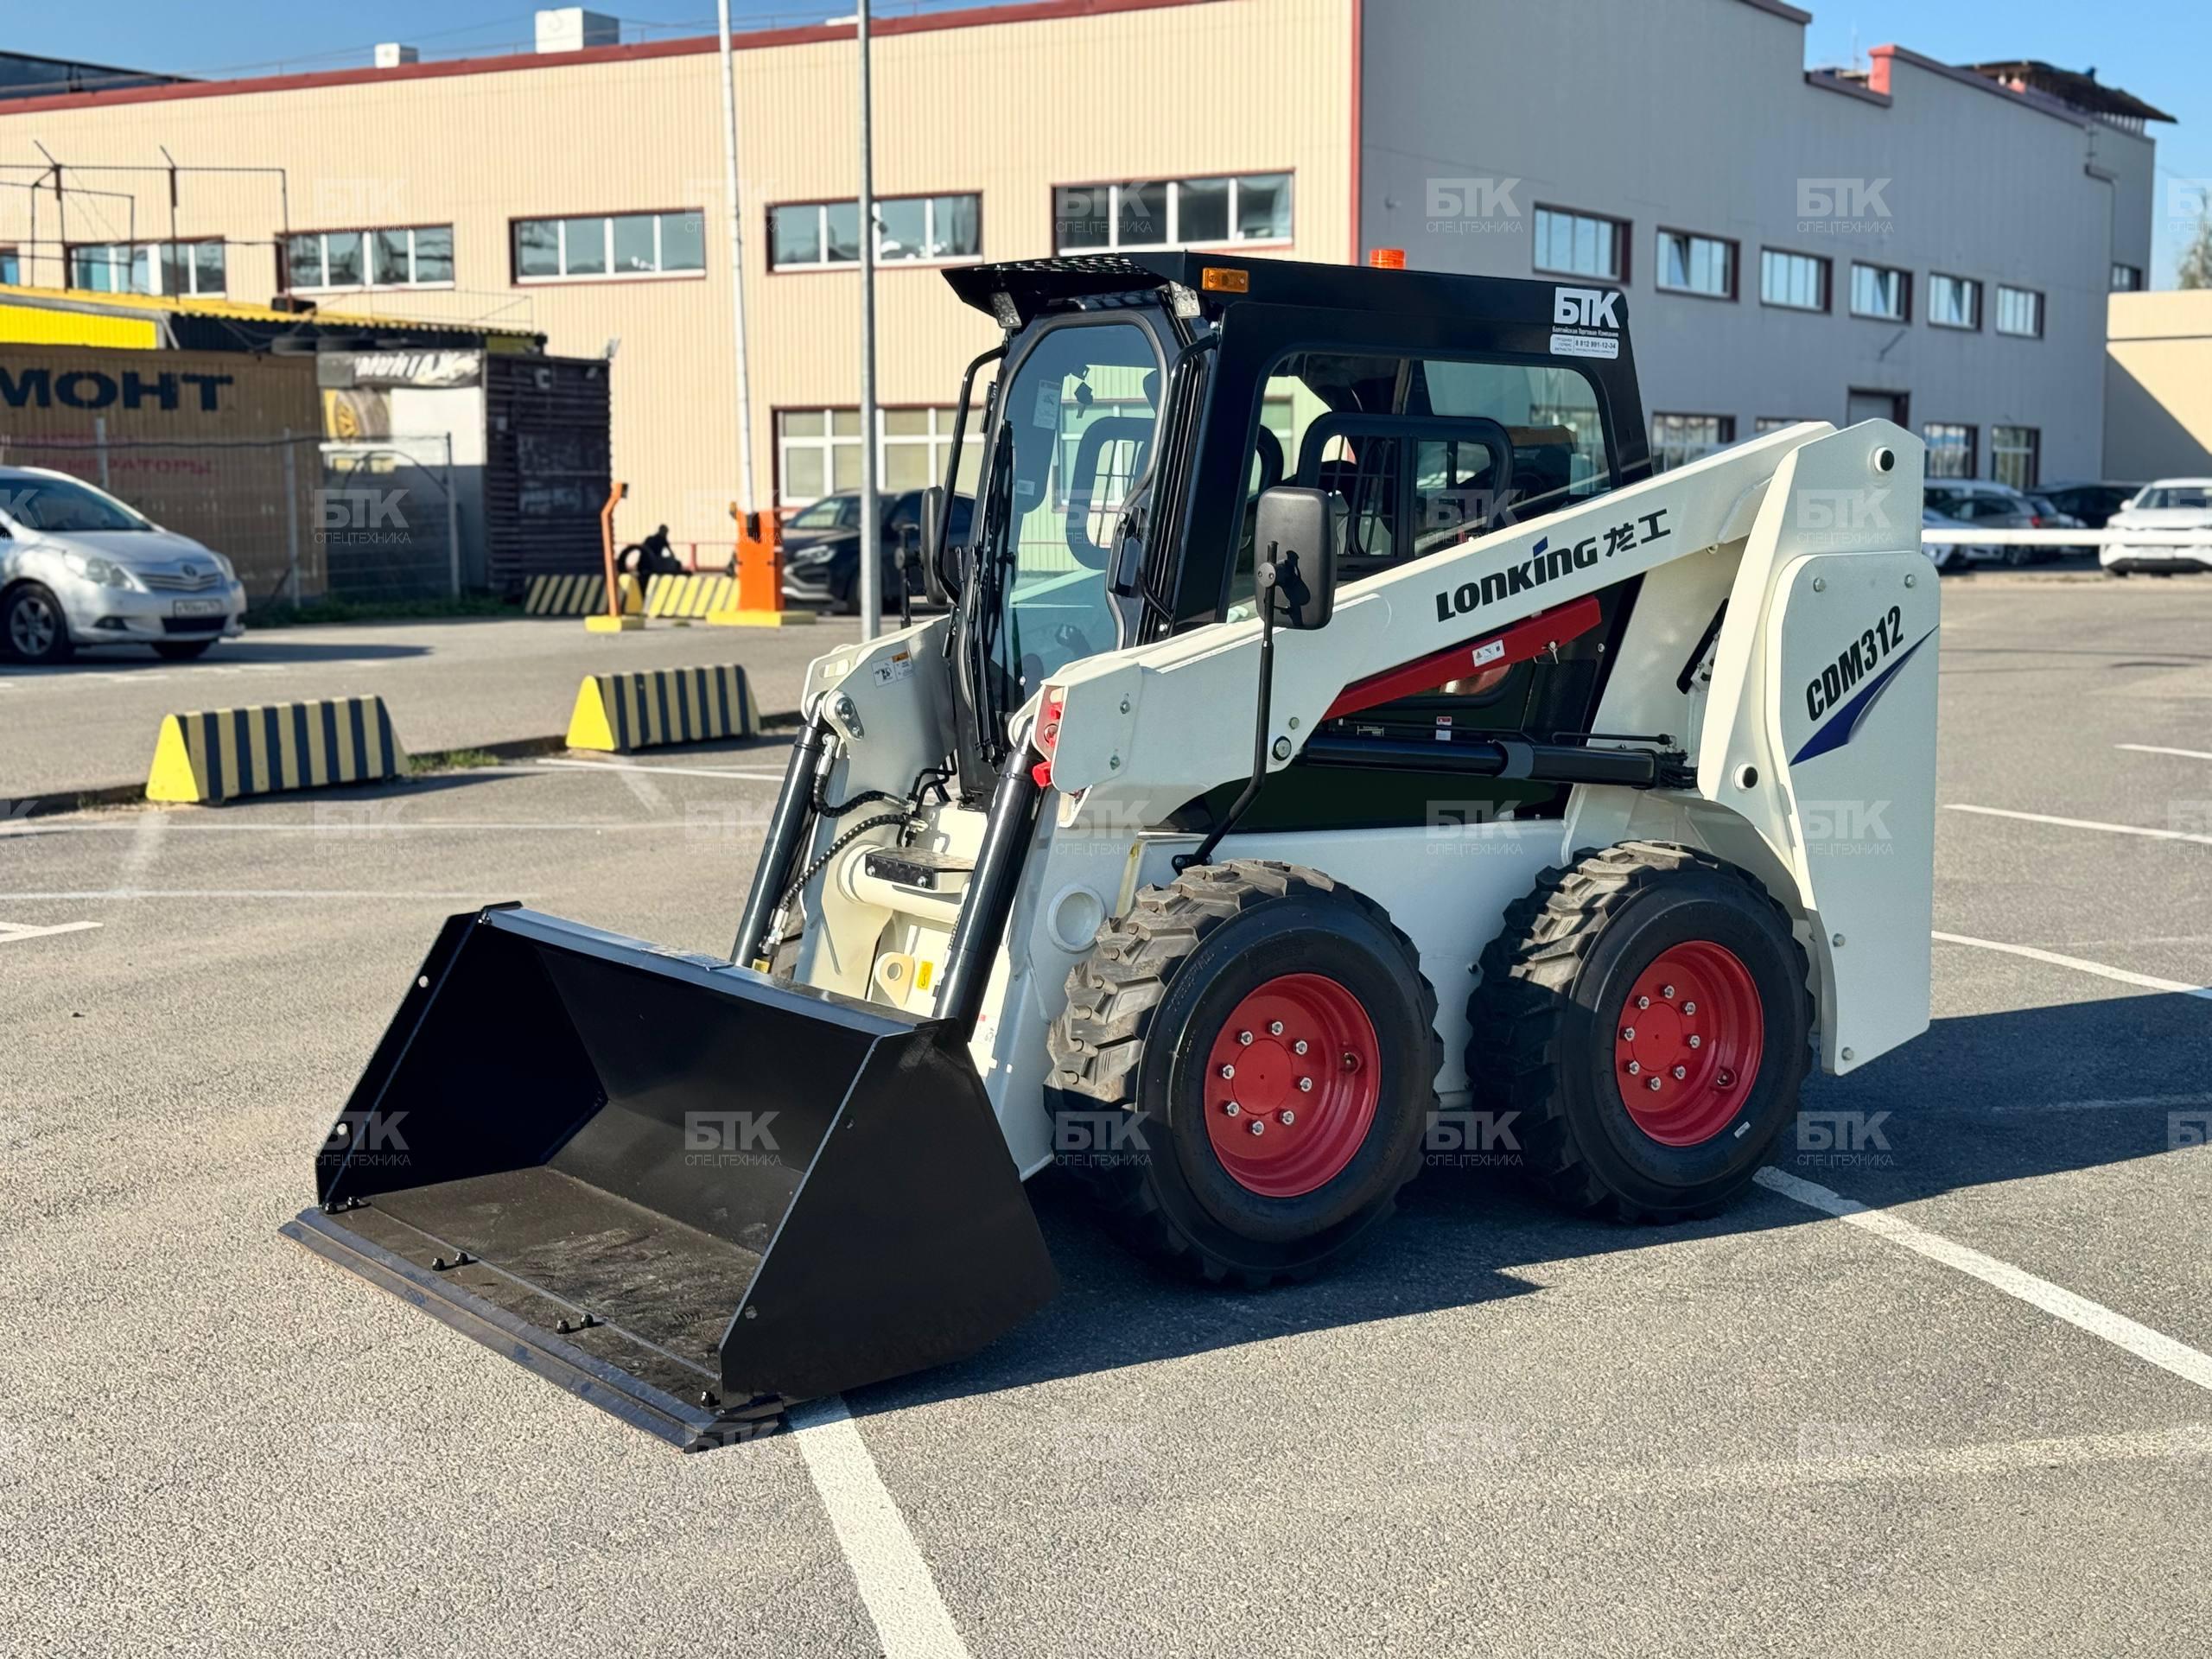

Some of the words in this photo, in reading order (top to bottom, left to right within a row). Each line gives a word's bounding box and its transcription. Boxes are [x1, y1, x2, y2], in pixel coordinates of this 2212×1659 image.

[1554, 286, 1620, 328] БТК
[1603, 509, 1671, 557] 龙工
[1806, 606, 1904, 721] CDM312
